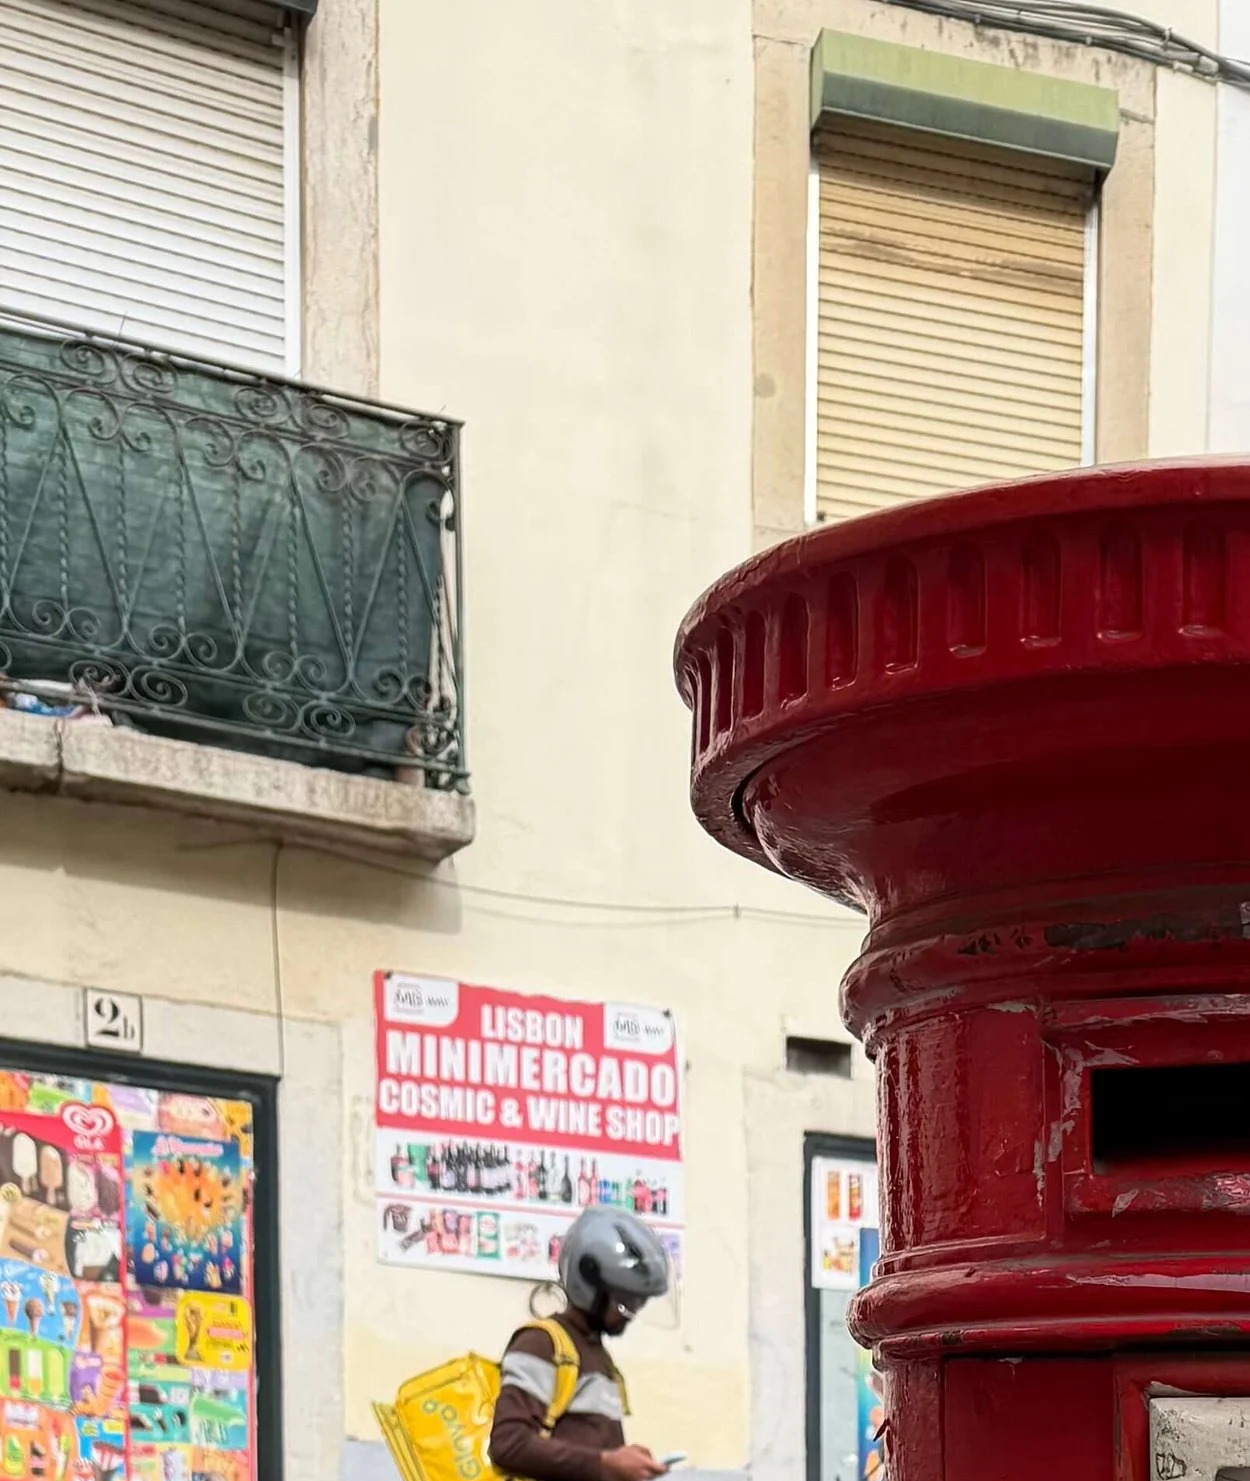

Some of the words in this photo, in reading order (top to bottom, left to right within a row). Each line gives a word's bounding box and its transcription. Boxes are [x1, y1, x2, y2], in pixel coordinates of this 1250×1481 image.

[480, 1004, 583, 1049] LISBON
[385, 1030, 675, 1107] MINIMERCADO
[378, 1079, 496, 1124] COSMIC
[500, 1097, 523, 1129] &
[526, 1095, 603, 1138] WINE
[605, 1105, 681, 1147] SHOP
